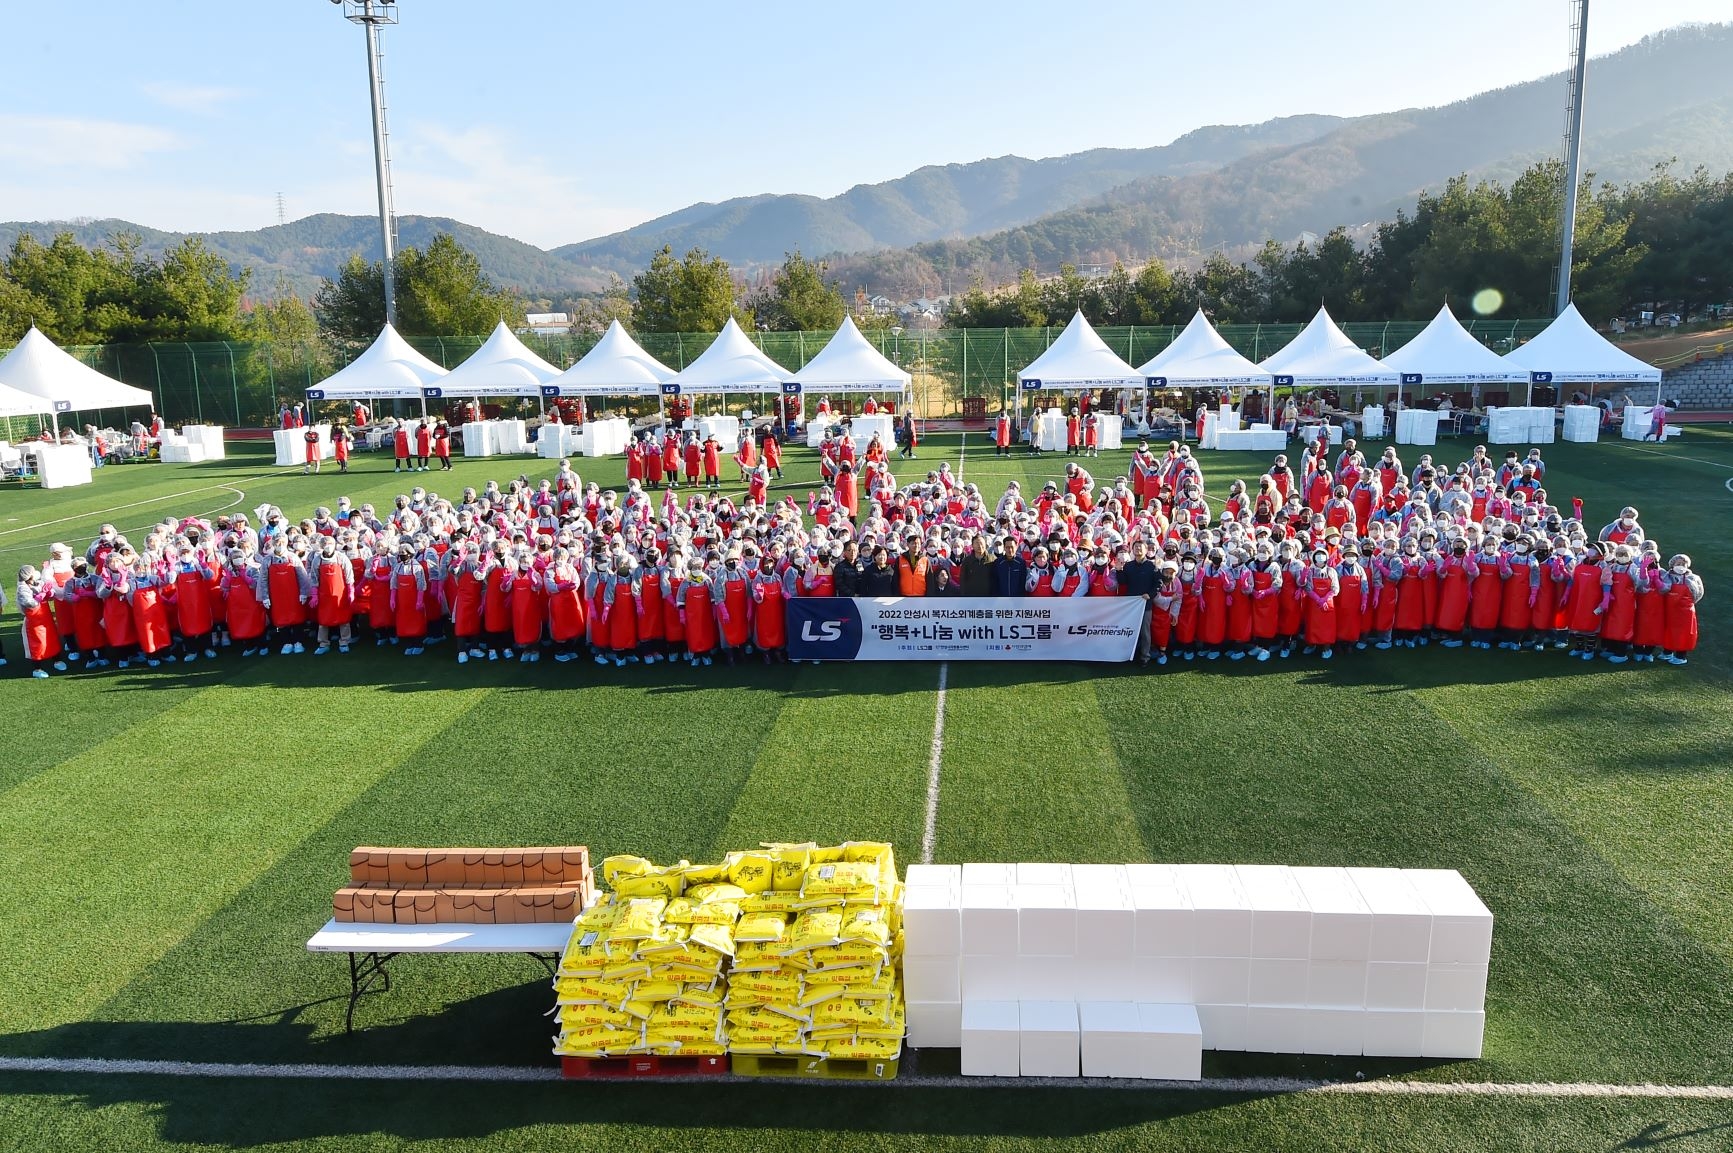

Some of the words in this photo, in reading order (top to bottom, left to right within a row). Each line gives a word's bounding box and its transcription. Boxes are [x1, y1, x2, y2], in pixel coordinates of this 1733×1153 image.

[879, 610, 901, 618] 2022
[904, 610, 930, 619] 안성시
[932, 610, 993, 619] 복지소외계층을
[996, 610, 1013, 618] 위한
[1016, 610, 1050, 618] 지원사업
[802, 621, 841, 641] LS
[958, 625, 994, 639] with
